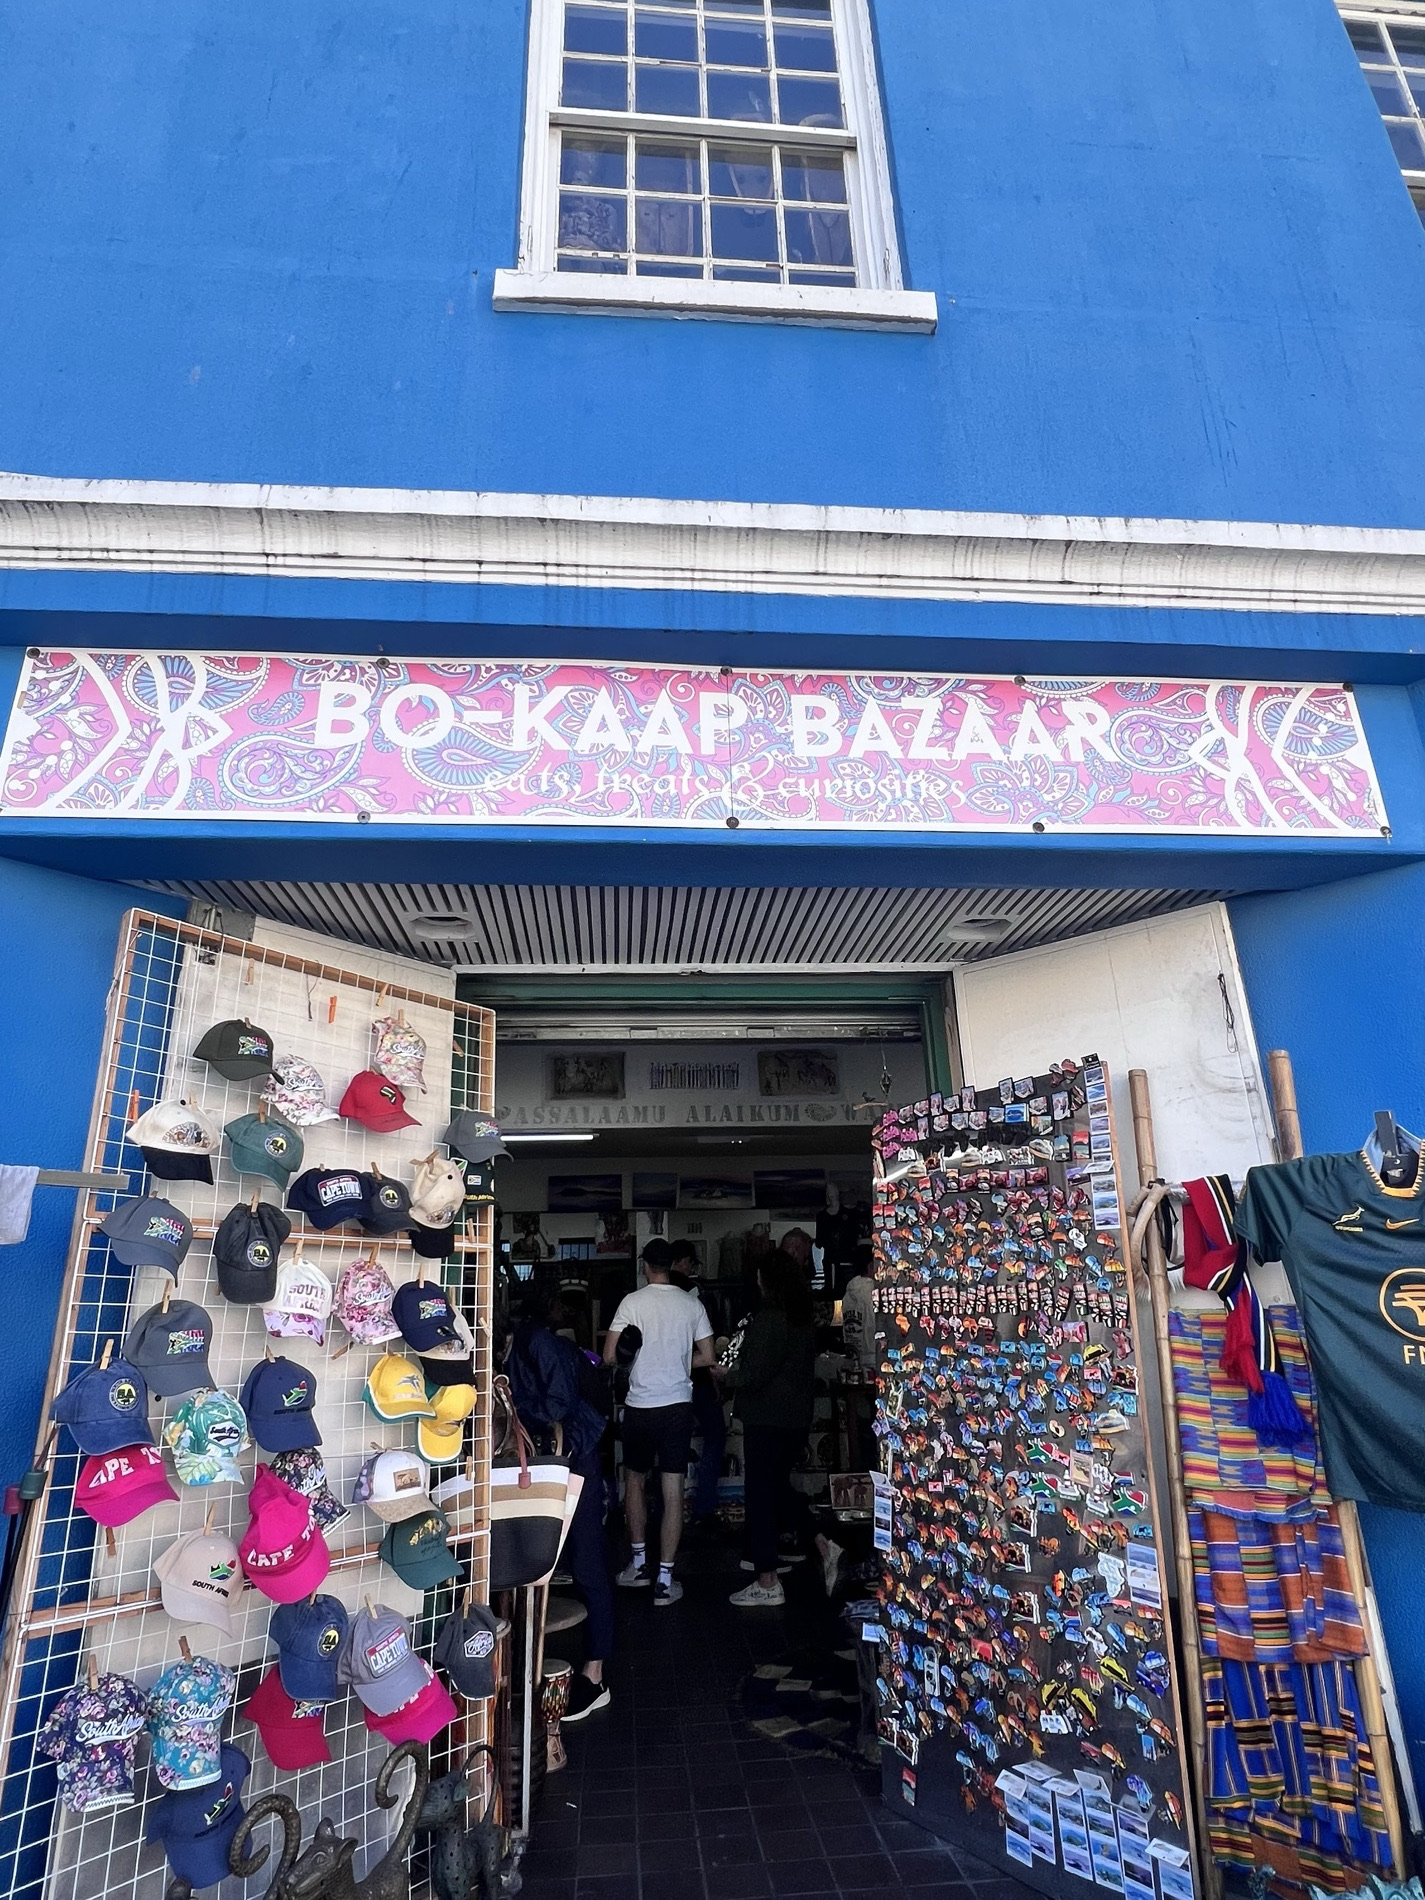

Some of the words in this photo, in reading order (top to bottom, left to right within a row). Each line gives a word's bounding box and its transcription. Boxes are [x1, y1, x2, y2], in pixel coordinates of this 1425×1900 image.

[314, 681, 749, 755] BO-KAAP
[791, 694, 1123, 762] BAZAAR
[596, 765, 708, 795] treats
[778, 769, 966, 808] curiosities
[513, 1105, 666, 1125] ASSALAAMU
[686, 1104, 799, 1123] ALAIKUM
[192, 1580, 215, 1592] SOUTH
[76, 1718, 119, 1743] South
